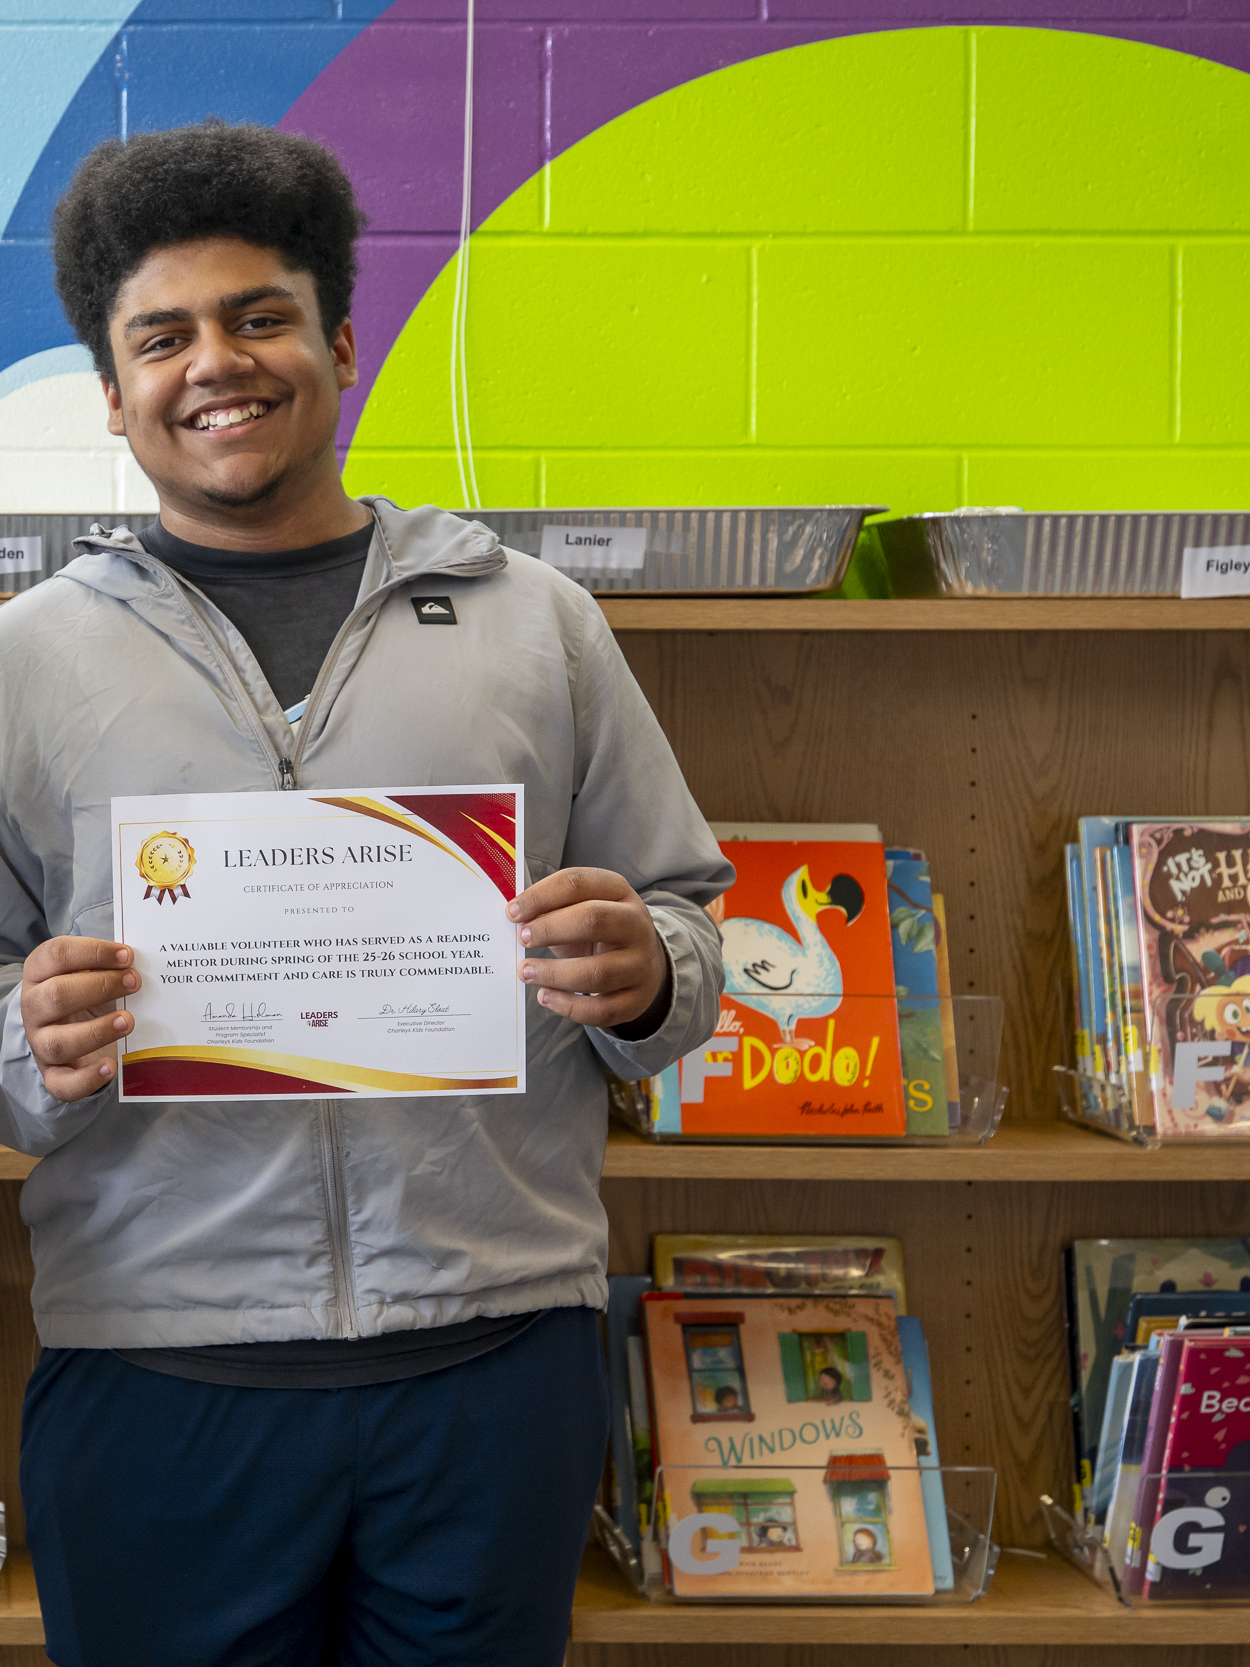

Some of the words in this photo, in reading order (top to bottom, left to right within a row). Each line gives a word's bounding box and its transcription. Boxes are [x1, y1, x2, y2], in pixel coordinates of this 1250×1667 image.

[565, 533, 612, 546] Lanier
[1206, 559, 1250, 575] Figley
[224, 846, 334, 867] LEADERS
[341, 844, 412, 863] ARISE
[243, 883, 304, 893] CERTIFICATE
[307, 883, 320, 891] OF
[322, 880, 393, 890] APPRECIATION
[1169, 862, 1212, 901] NOT
[1217, 887, 1245, 903] AND
[284, 906, 337, 914] PRESENTED
[170, 942, 227, 951] VALUABLE
[230, 939, 300, 949] VOLUNTEER
[303, 938, 332, 947] WHO
[335, 937, 358, 946] HAS
[361, 936, 405, 945] SERVED
[408, 935, 422, 943] AS
[425, 935, 432, 943] A
[436, 933, 489, 942] READING
[166, 958, 217, 967] MENTOR
[220, 956, 267, 966] DURING
[271, 955, 314, 964] SPRING
[317, 954, 332, 963] OF
[335, 953, 359, 962] THE
[362, 950, 395, 961] 25-26
[398, 950, 447, 960] SCHOOL
[450, 949, 483, 958] YEAR.
[159, 974, 192, 983] YOUR
[196, 972, 279, 982] COMMITMENT
[282, 971, 308, 980] AND
[311, 970, 342, 979] CARE
[346, 969, 356, 978] IS
[358, 968, 395, 977] TRULY
[399, 965, 493, 976] COMMENDABLE.
[203, 1002, 237, 1021] Amanda
[300, 1012, 338, 1020] LEADERS
[379, 1004, 396, 1015] Dr.
[311, 1019, 328, 1027] ARISE
[742, 1018, 880, 1091] Dodo!
[680, 1036, 739, 1104] F
[1172, 1040, 1232, 1109] F
[705, 1411, 864, 1467] WINDOWS
[668, 1512, 742, 1576] G
[1150, 1507, 1226, 1570] G
